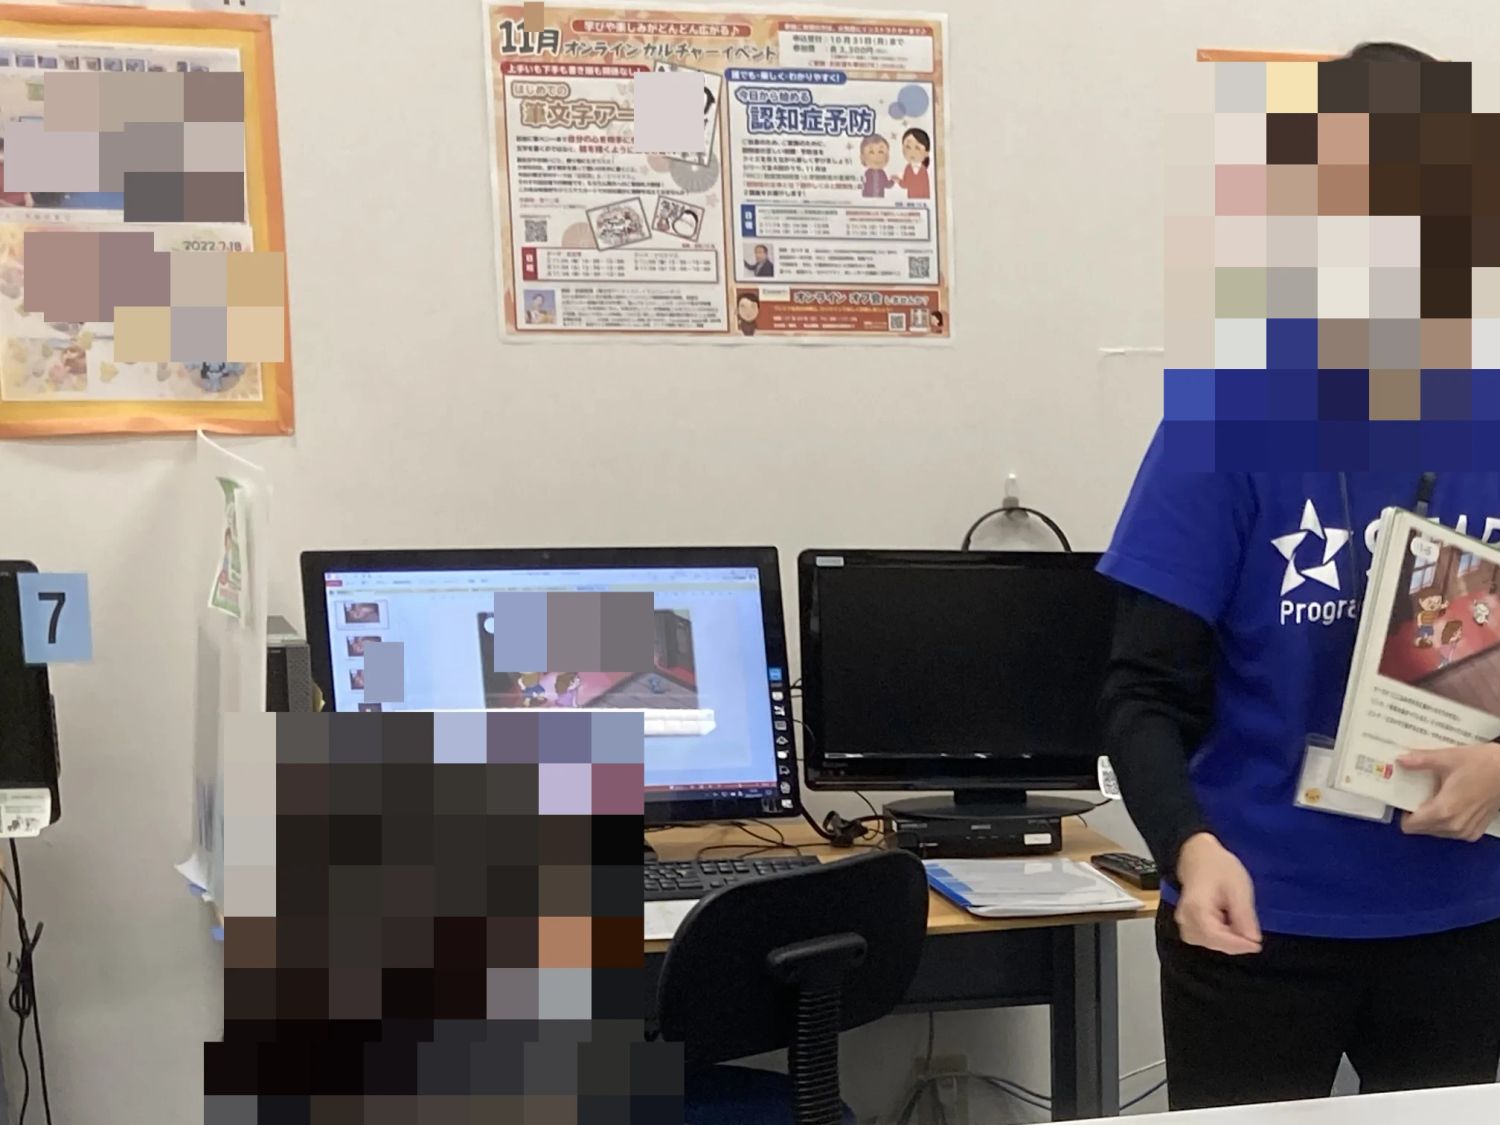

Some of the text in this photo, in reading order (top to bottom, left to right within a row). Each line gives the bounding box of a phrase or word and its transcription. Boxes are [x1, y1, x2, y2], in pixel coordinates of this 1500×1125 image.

[498, 20, 561, 55] 11月
[514, 84, 568, 96] はじめての
[750, 106, 873, 134] 認知症予防
[38, 592, 66, 644] 7
